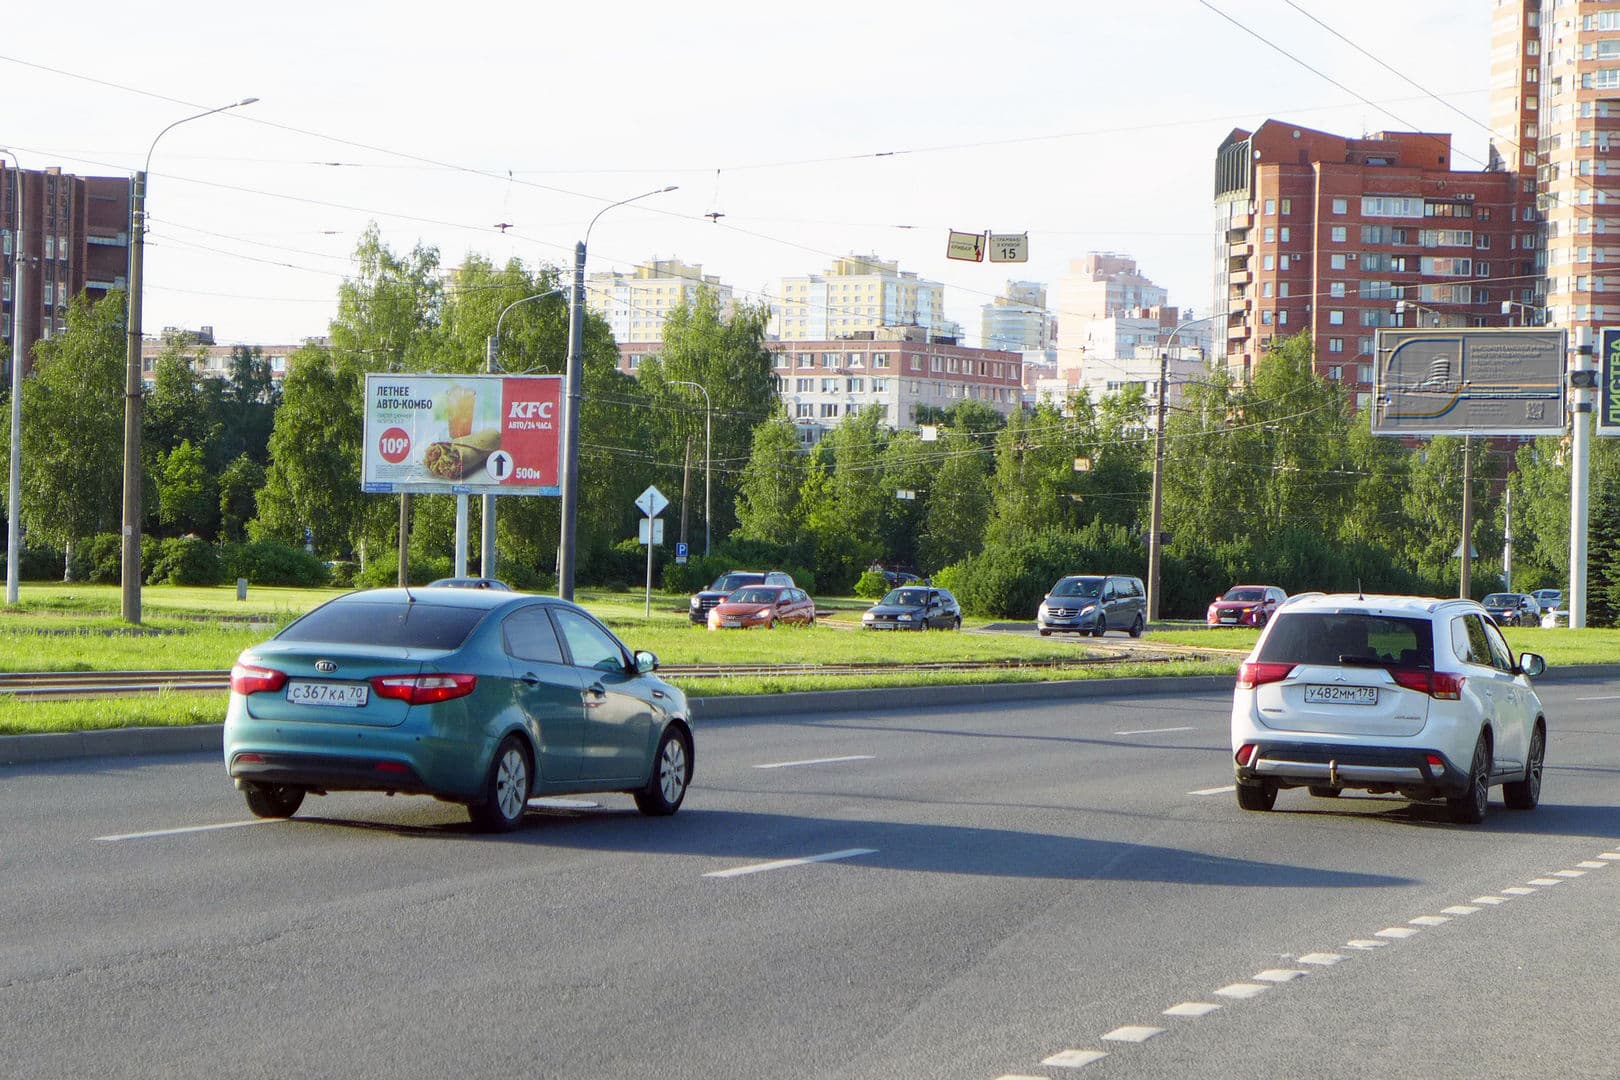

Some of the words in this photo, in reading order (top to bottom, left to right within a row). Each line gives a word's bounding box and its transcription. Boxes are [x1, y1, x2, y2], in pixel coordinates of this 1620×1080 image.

[1001, 248, 1016, 259] 15
[376, 386, 410, 397] ЛЕТНЕЕ
[376, 399, 433, 410] АВТО-КОМБО
[508, 401, 553, 419] KFC
[536, 421, 553, 430] ЧАСА
[318, 663, 335, 672] KIA
[349, 687, 363, 698] 70
[1356, 688, 1375, 698] 178
